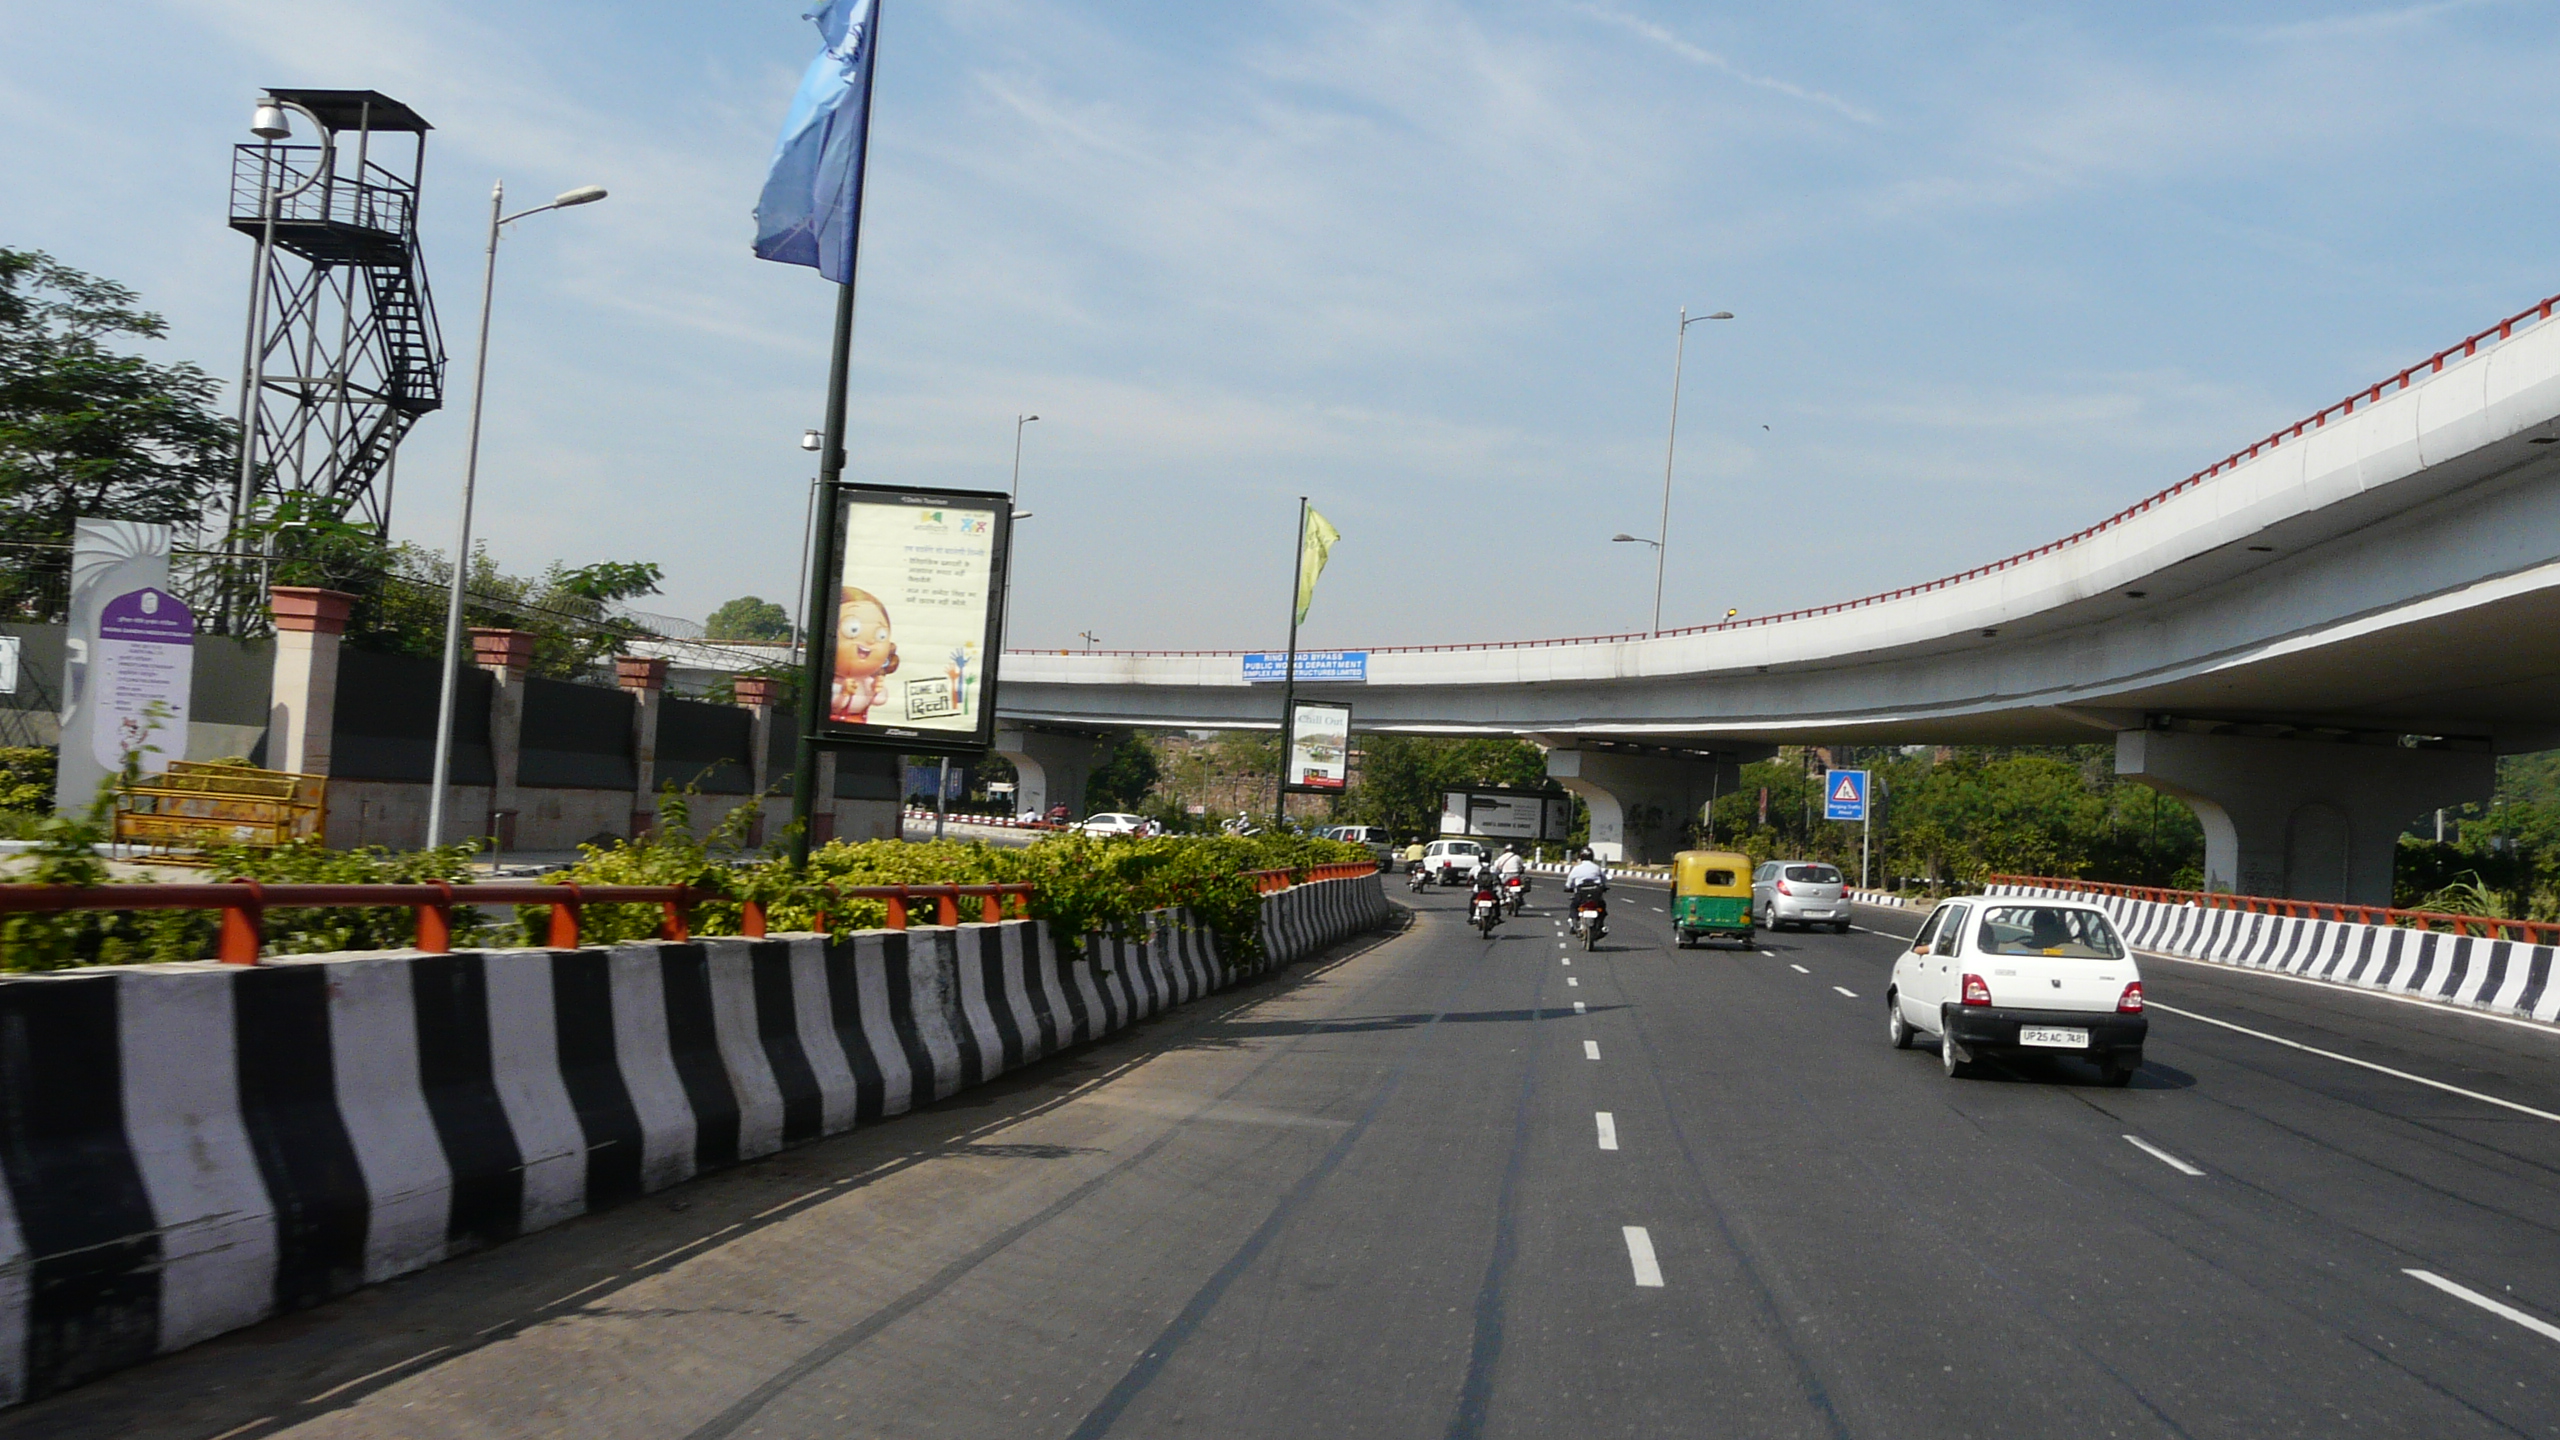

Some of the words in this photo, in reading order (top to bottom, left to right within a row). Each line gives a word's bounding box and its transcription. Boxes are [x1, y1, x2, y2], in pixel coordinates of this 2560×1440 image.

[1264, 654, 1283, 662] RING
[1310, 652, 1344, 661] BYPASS
[1245, 662, 1274, 670] PUBLIC
[1275, 661, 1303, 669] WOKS
[1305, 660, 1362, 669] DEPARTMENT
[1271, 669, 1336, 677] INFRSTRUCTURES
[1337, 668, 1362, 676] LIMITED
[1298, 714, 1322, 725] Chill
[1325, 716, 1344, 727] Out
[2050, 1033, 2062, 1042] AC
